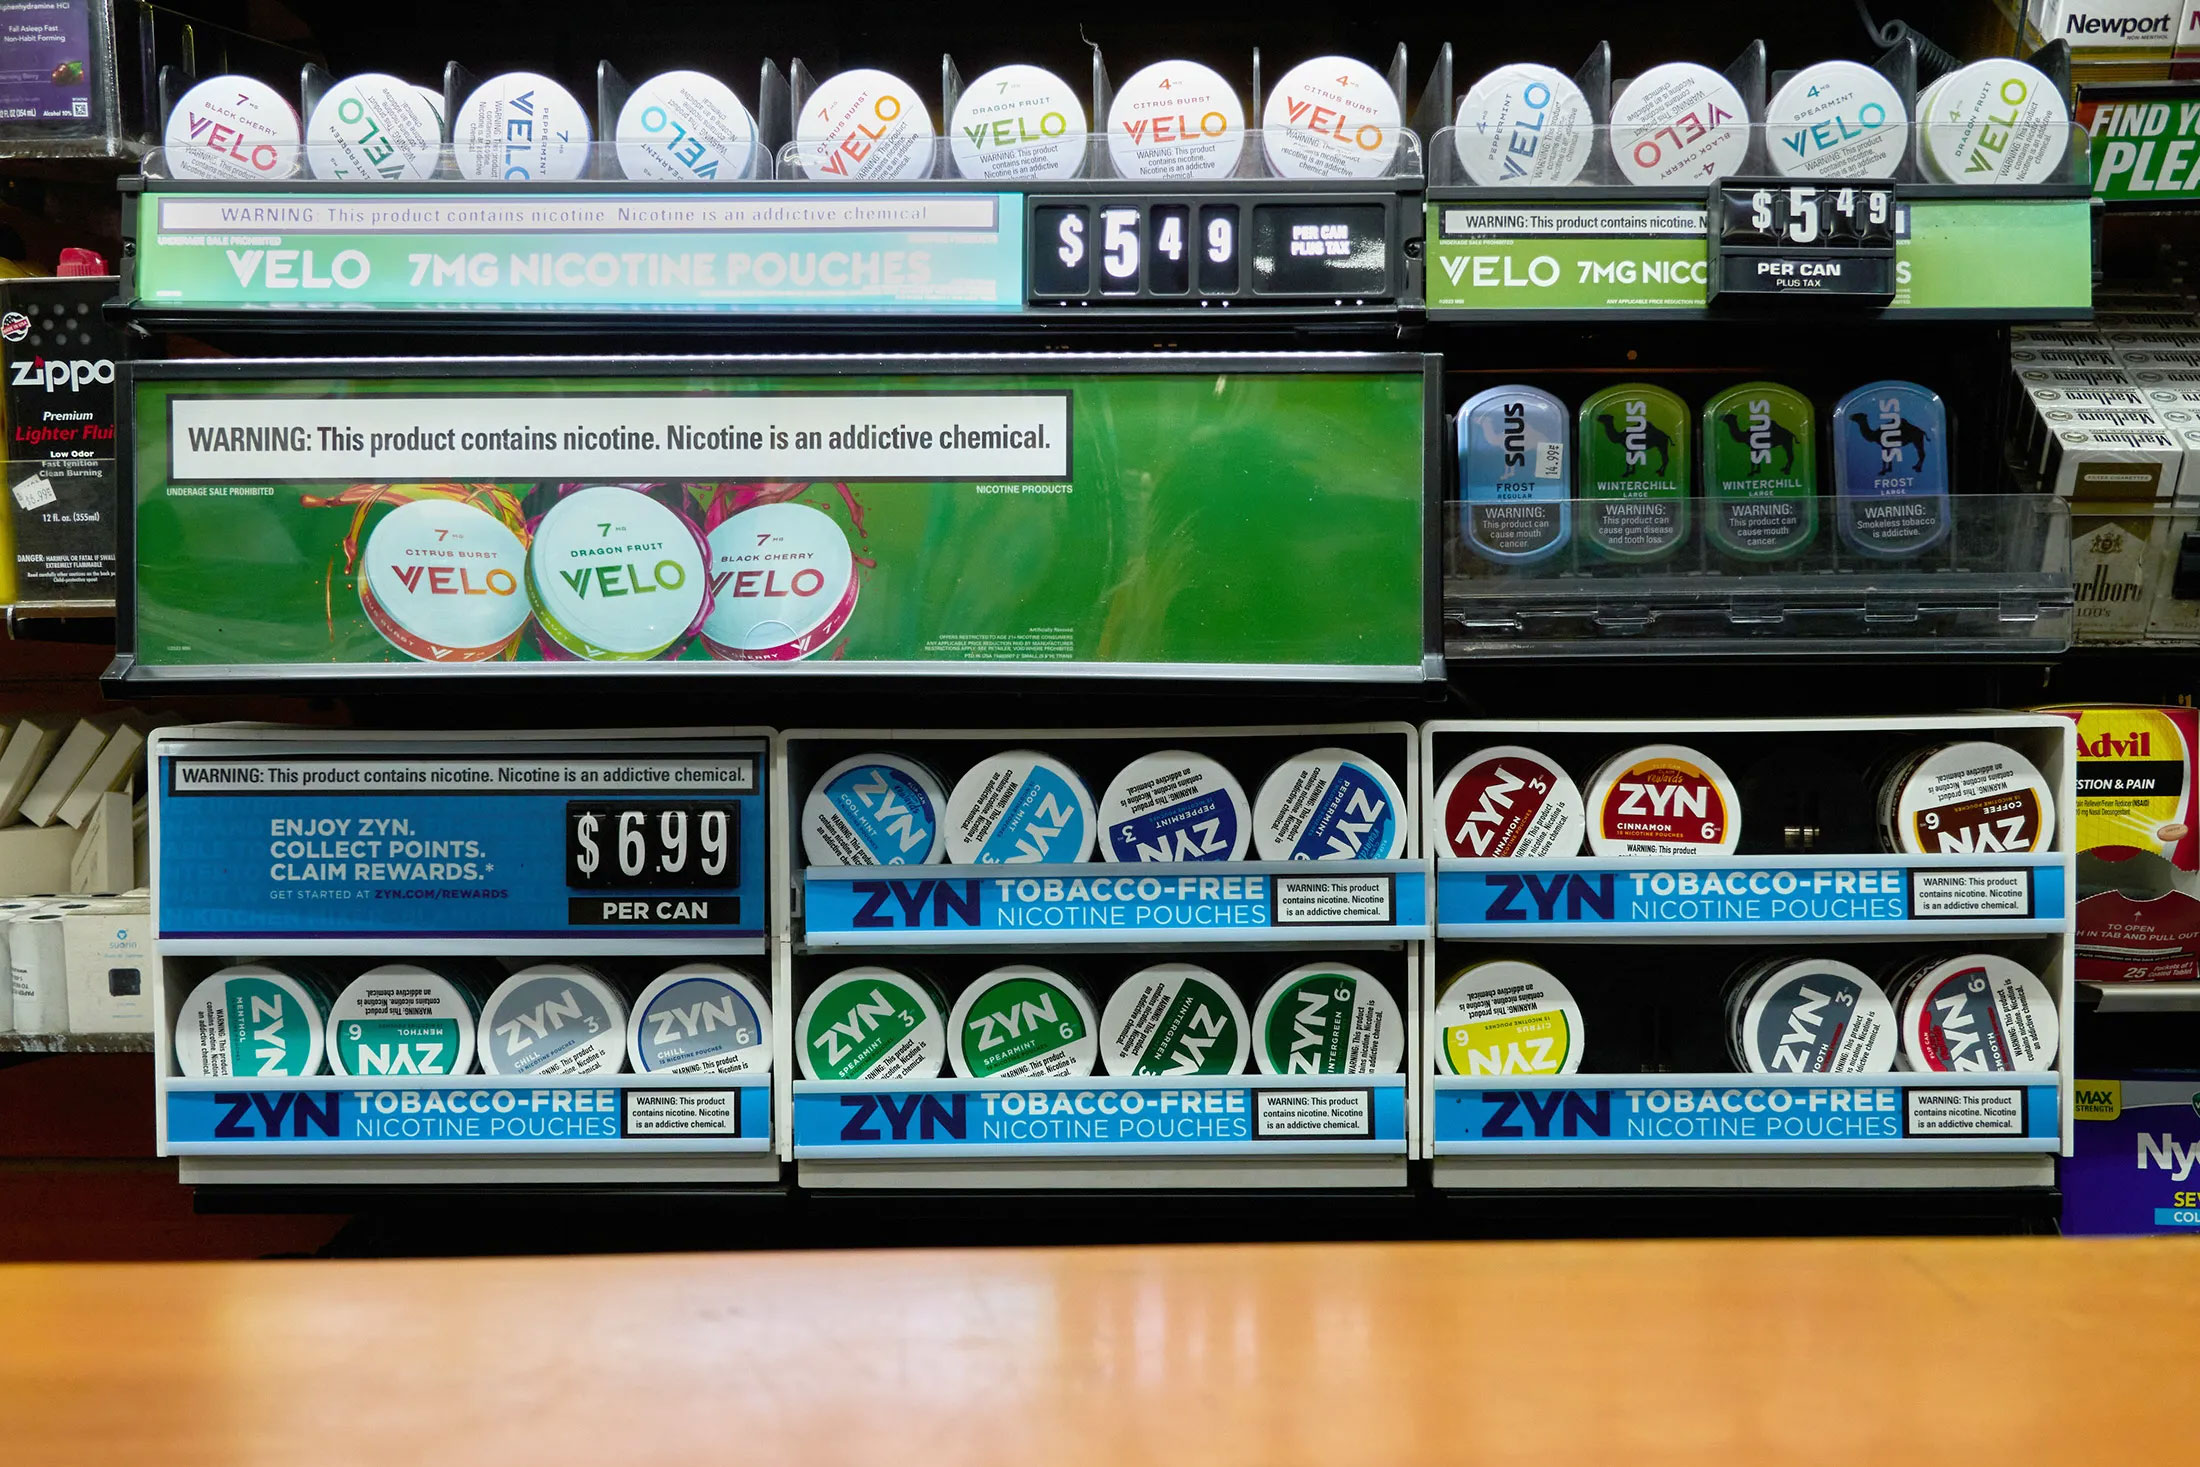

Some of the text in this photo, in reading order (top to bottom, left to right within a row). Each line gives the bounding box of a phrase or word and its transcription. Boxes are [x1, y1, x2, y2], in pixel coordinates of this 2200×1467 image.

[21, 25, 43, 34] Asleep
[44, 24, 59, 32] Fast
[2066, 13, 2171, 37] Newport
[38, 34, 67, 43] Forming
[973, 97, 1051, 115] DRAGON FRUIT
[1133, 96, 1211, 109] CITRUS BURST
[1304, 85, 1379, 116] CITRUS BURST
[1793, 93, 1855, 121] SPEARMINT
[204, 101, 278, 137] BLACK CHERRY
[1287, 96, 1383, 151] VELO
[2088, 103, 2171, 137] FIND
[820, 95, 901, 177] VELO
[963, 112, 1067, 150] VELO
[1123, 111, 1228, 146] VELO
[1499, 82, 1551, 181] VELO
[189, 111, 279, 171] VELO
[540, 107, 549, 176] PEPPERMINT
[328, 206, 365, 222] This
[371, 206, 441, 226] product
[447, 205, 525, 222] contains
[618, 206, 695, 222] Nicotine
[702, 206, 718, 222] is
[726, 210, 745, 221] an
[751, 206, 836, 222] addictive
[1465, 216, 1528, 229] WARNING:
[1530, 215, 1554, 229] This
[1556, 215, 1599, 231] product
[1600, 215, 1648, 229] contains
[1649, 215, 1697, 229] nicotine.
[1292, 225, 1348, 240] PER CAN
[1327, 241, 1350, 255] TAX
[227, 250, 932, 288] VELO 7MG NICOTINE POUCHES
[1439, 256, 1636, 287] VELO 7MG
[1757, 263, 1841, 275] PER CAN
[1776, 279, 1821, 287] PLUS TAX
[10, 356, 115, 392] zippo
[2065, 392, 2142, 405] Marlboro
[43, 410, 94, 422] Premium
[2077, 412, 2155, 426] Marlboro
[16, 424, 115, 445] Lighter Flui
[188, 424, 1051, 458] WARNING: This product contains nicotine. Nicotine is an addictive chemical.
[1503, 402, 1525, 467] snus
[1625, 401, 1647, 466] snus
[2092, 434, 2172, 448] Marlboro
[62, 460, 99, 468] Ignition
[66, 469, 103, 478] Burning
[167, 486, 275, 496] UNDERAGE SALE PROHIBITED
[976, 485, 1074, 494] NICOTINE PRODUCTS
[1496, 482, 1535, 492] FROST
[1597, 481, 1676, 491] WINTERCHILL
[1722, 479, 1802, 491] WINTERCHILL
[1874, 477, 1914, 489] FROST
[43, 513, 52, 522] 12
[1485, 507, 1546, 518] WARNING:
[1864, 504, 1926, 518] WARNING:
[1625, 525, 1673, 535] gum disease
[1856, 517, 1936, 530] Smokeless tobacco
[1881, 527, 1921, 538] addictive.
[1490, 529, 1541, 539] cause mouth
[570, 542, 664, 558] DRAGON FRUIT
[720, 551, 816, 563] BLACK CHERRY
[2076, 731, 2150, 758] Advil
[182, 766, 746, 786] WARNING: This product contains nicotine. Nicotine is an addictive chemical.
[2114, 779, 2156, 790] & PAIN
[1617, 783, 1710, 818] ZYN
[1983, 800, 2022, 815] COFFEE
[853, 769, 927, 853] ZYN
[1454, 767, 1526, 856] ZYN
[271, 818, 415, 837] ENJOY ZYN.
[1616, 823, 1671, 832] CINNAMON
[270, 840, 487, 858] COLLECT POINTS.
[270, 863, 349, 881] CLAIM
[270, 889, 510, 900] GET STARTED AT ZYN.COM/REWARDS
[853, 876, 1265, 928] ZYN TOBACCO-FREE
[1485, 870, 1901, 921] ZYN TOBACCO-FREE
[603, 901, 709, 919] PER CAN
[998, 904, 1267, 926] NICOTINE POUCHES
[1632, 898, 1903, 919] NICOTINE POUCHES
[2123, 967, 2148, 979] 25
[236, 996, 247, 1044] MENTHOL
[1154, 996, 1194, 1061] WINTERGREEN
[1517, 1022, 1552, 1034] CITRUS
[358, 1043, 444, 1076] ZYN
[513, 1051, 542, 1069] CHILL
[838, 1037, 884, 1078] SPEARMINT
[983, 1040, 1036, 1067] SPEARMINT
[2075, 1091, 2113, 1105] MAX
[214, 1089, 616, 1138] ZYN TOBACCO-FREE
[840, 1090, 1245, 1140] ZYN TOBACCO-FREE
[1482, 1088, 1895, 1138] ZYN TOBACCO-FREE
[2075, 1105, 2114, 1113] STRENGTH
[357, 1116, 617, 1137] NICOTINE POUCHES
[984, 1118, 1247, 1139] NICOTINE POUCHES
[1628, 1116, 1897, 1137] NICOTINE POUCHES
